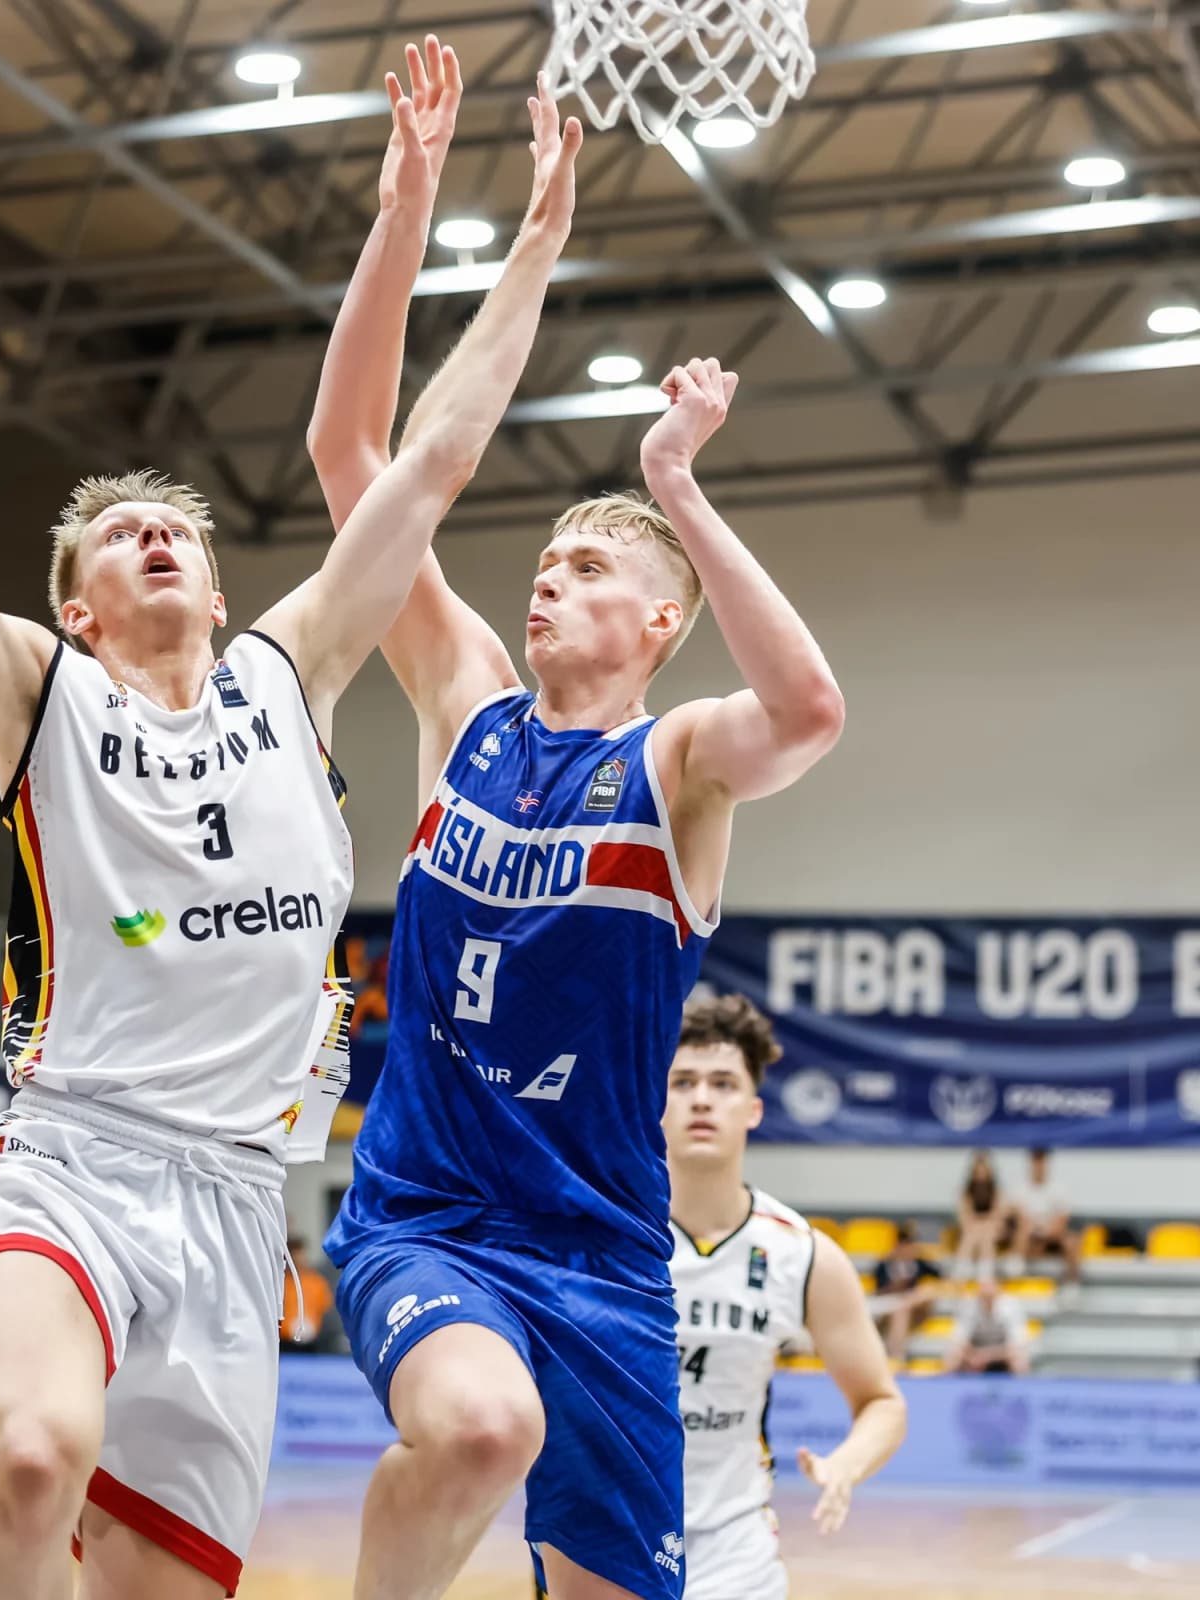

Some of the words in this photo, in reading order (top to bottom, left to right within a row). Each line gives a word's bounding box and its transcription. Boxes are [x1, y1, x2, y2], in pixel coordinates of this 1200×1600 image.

[100, 709, 280, 785] BELGIUM
[591, 785, 617, 797] FIBA
[197, 803, 233, 860] 3
[431, 797, 585, 900] ÍSLAND
[179, 887, 323, 941] crelan
[453, 938, 502, 1024] 9
[768, 929, 946, 1017] FIBA
[975, 929, 1139, 1020] U20
